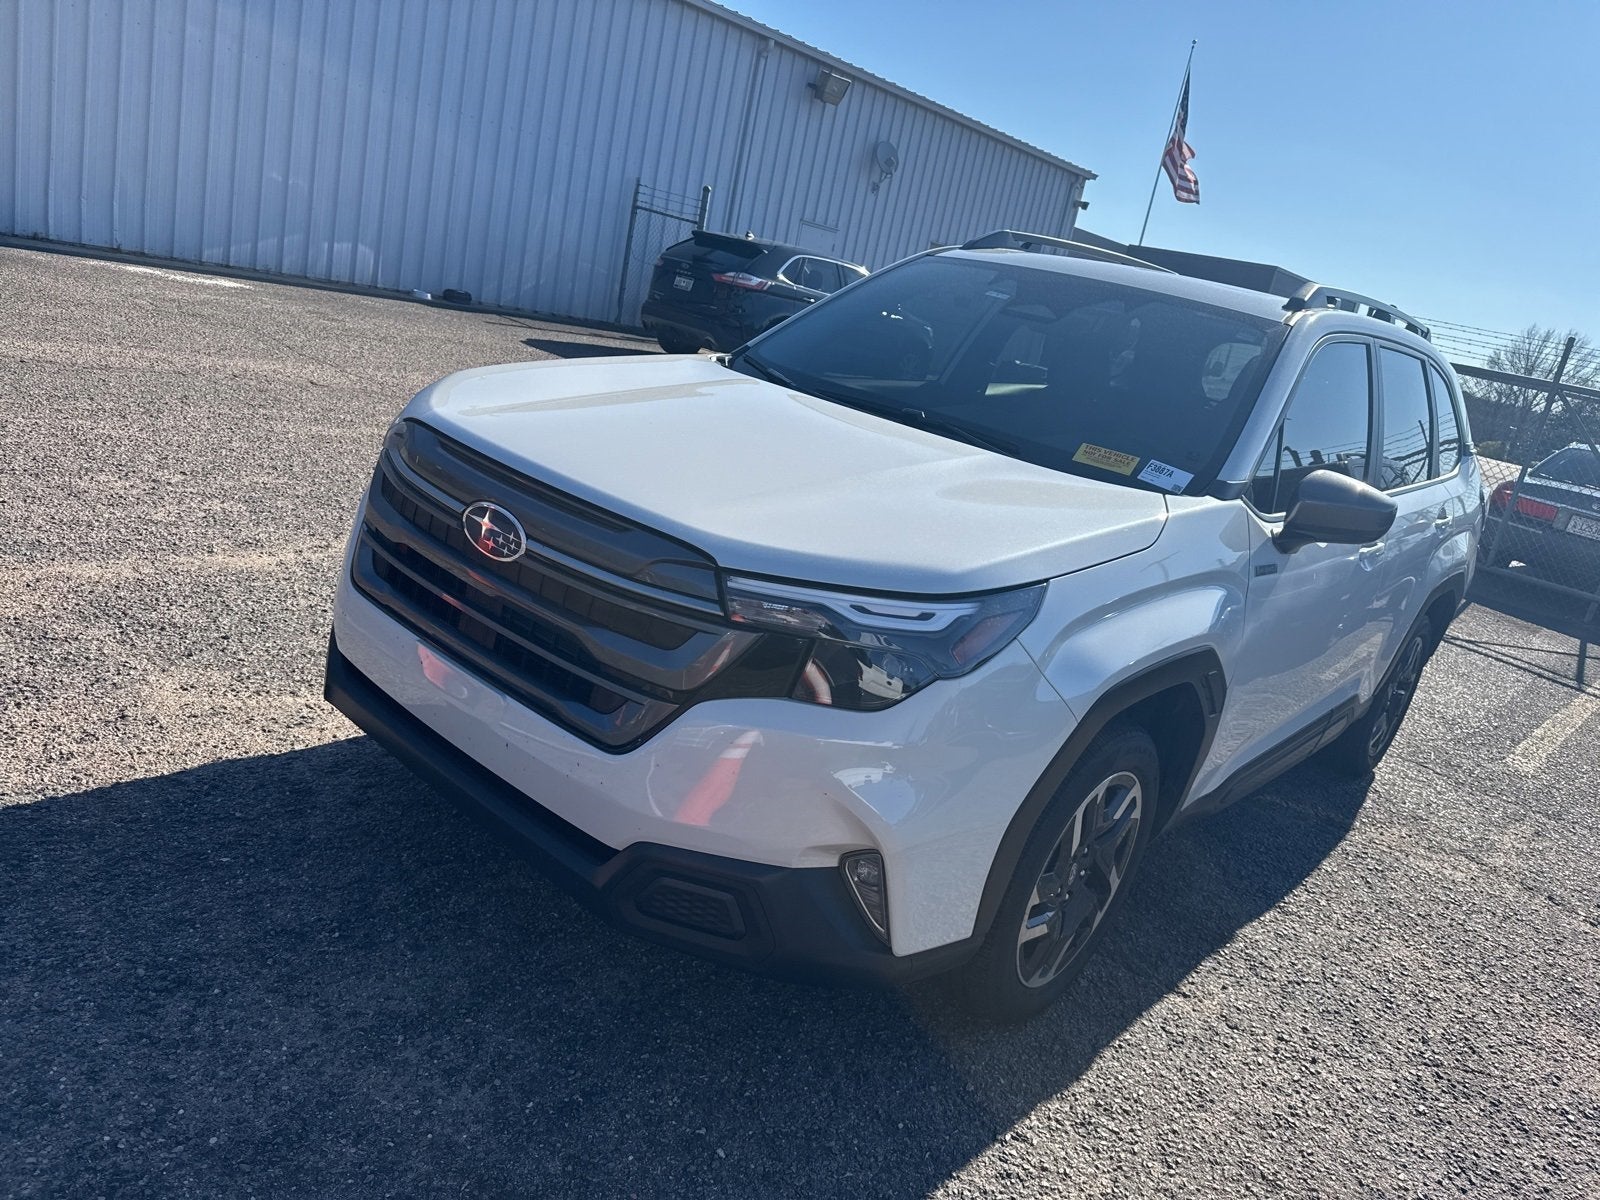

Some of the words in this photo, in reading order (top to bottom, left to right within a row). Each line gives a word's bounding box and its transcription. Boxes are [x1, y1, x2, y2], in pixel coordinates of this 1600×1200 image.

[1083, 449, 1097, 457] NOT
[1113, 458, 1131, 466] SALE
[1085, 444, 1102, 453] THIS
[1104, 450, 1136, 462] VEHICLE
[1146, 463, 1174, 478] F3887A
